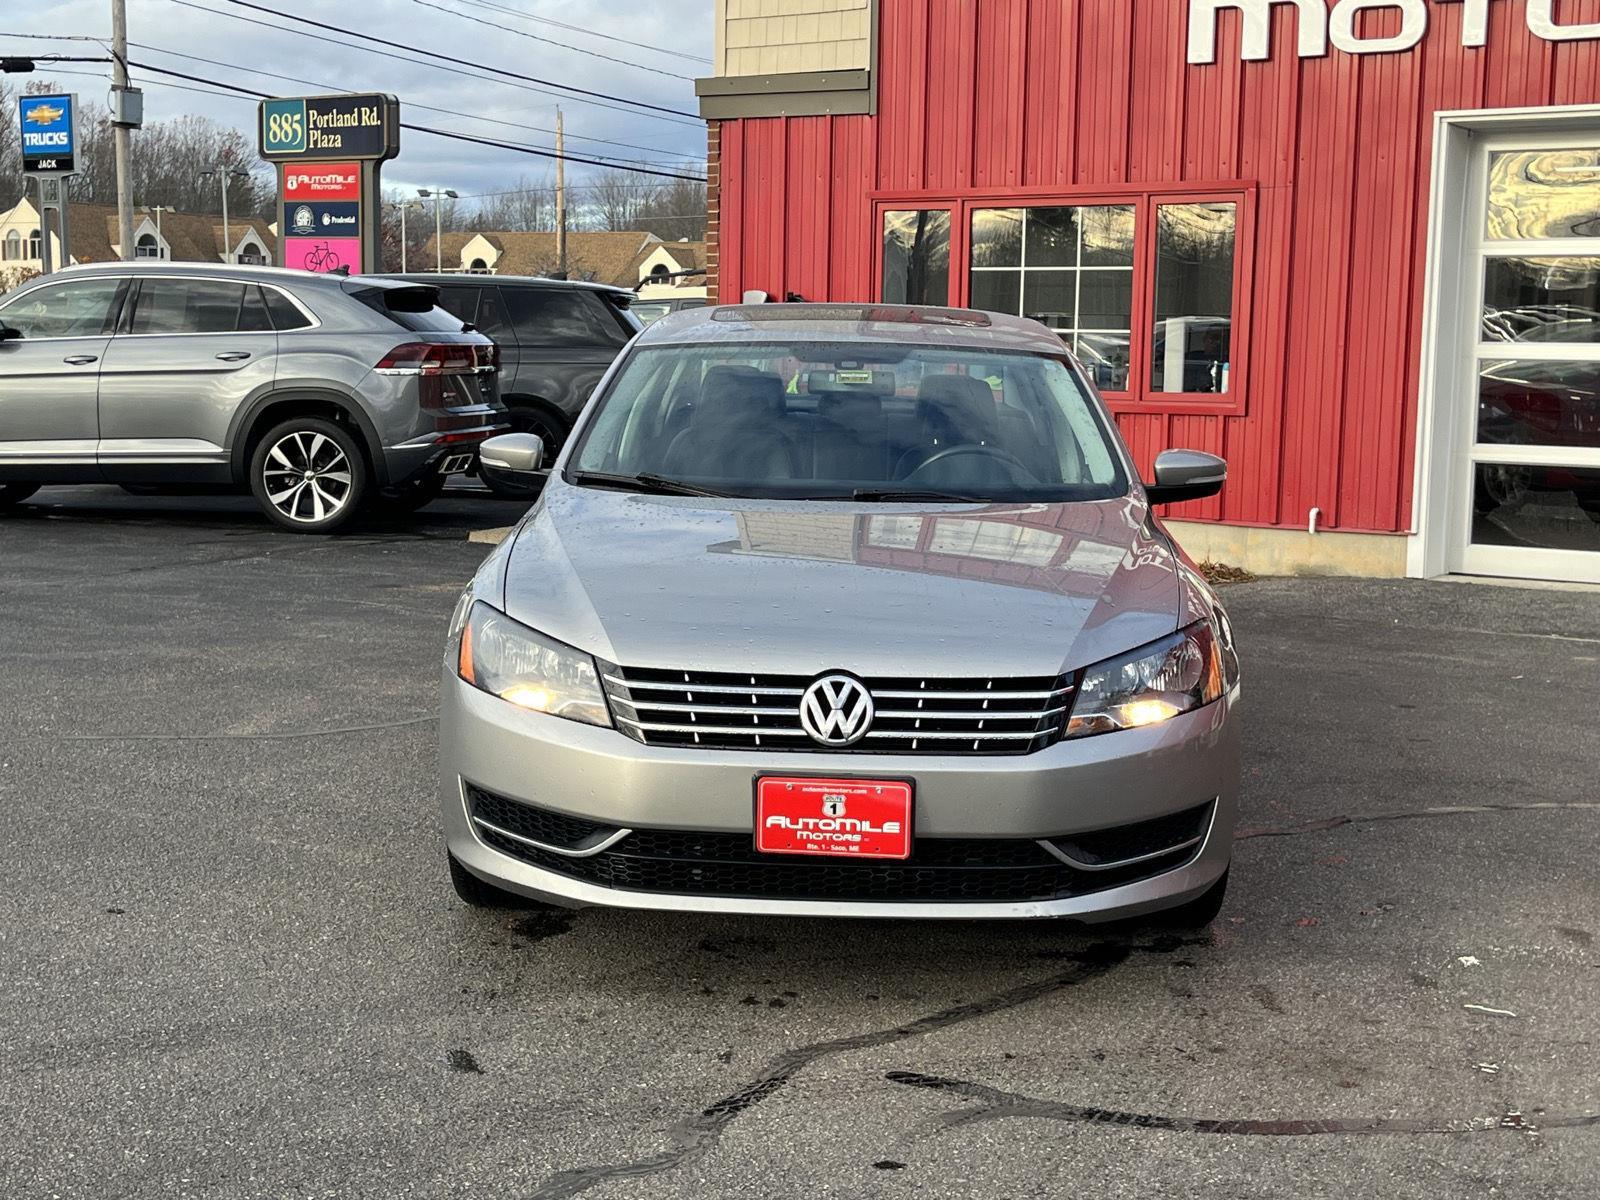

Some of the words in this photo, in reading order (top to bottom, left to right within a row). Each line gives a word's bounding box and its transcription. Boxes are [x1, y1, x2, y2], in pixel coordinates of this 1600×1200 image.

[308, 107, 359, 128] Portland
[360, 106, 381, 126] Rd.
[269, 113, 302, 145] 885
[24, 132, 68, 146] TRUCKS
[308, 129, 342, 148] Plaza
[38, 160, 57, 169] JACK
[830, 803, 837, 815] 1
[766, 815, 900, 833] AUTOMILE
[797, 831, 862, 842] MOTORS
